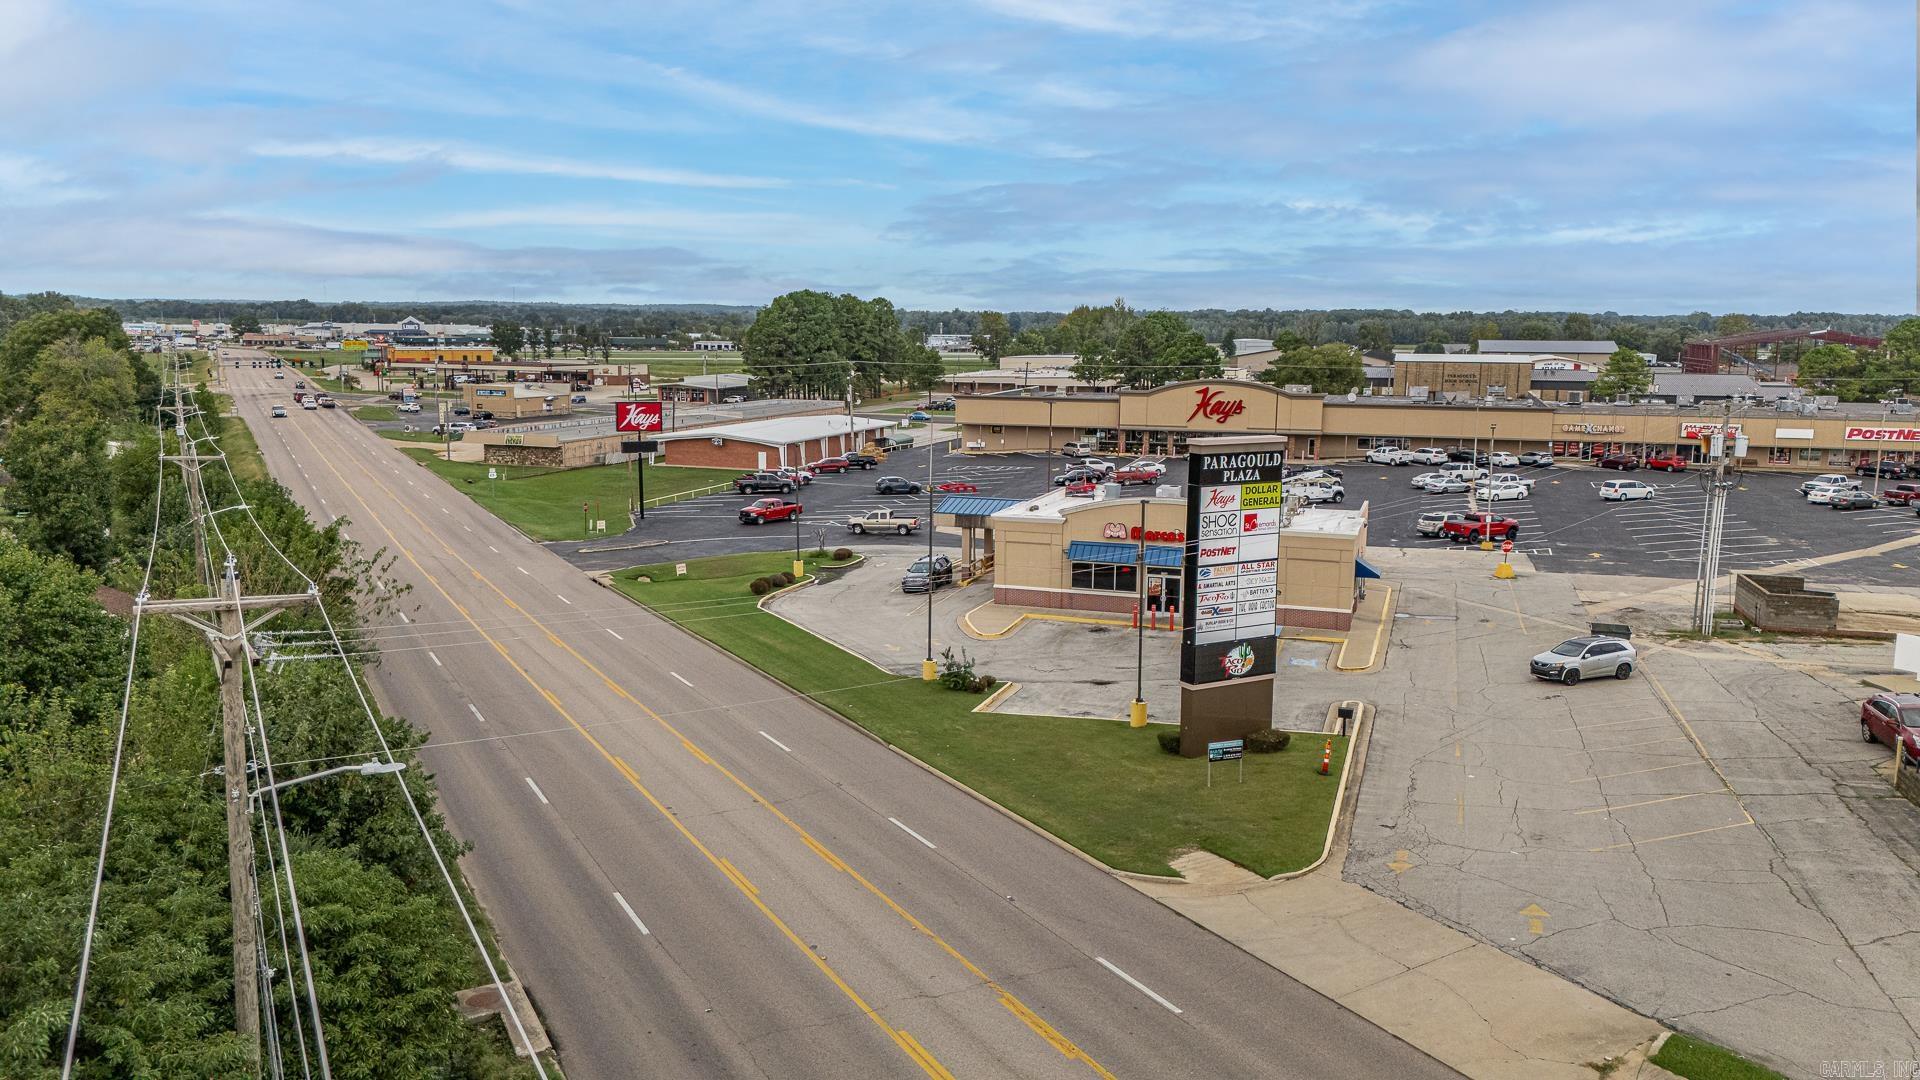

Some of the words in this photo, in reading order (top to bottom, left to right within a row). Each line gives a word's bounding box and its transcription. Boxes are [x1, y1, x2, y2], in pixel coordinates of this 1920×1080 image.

[1203, 453, 1281, 470] PARAGOULD
[1223, 469, 1261, 483] PLAZA
[1245, 485, 1278, 495] DOLLAR
[1242, 496, 1280, 507] GENERAL
[1241, 563, 1255, 571] ALL
[1256, 561, 1276, 569] STAR
[1249, 587, 1274, 596] BATTEN'S
